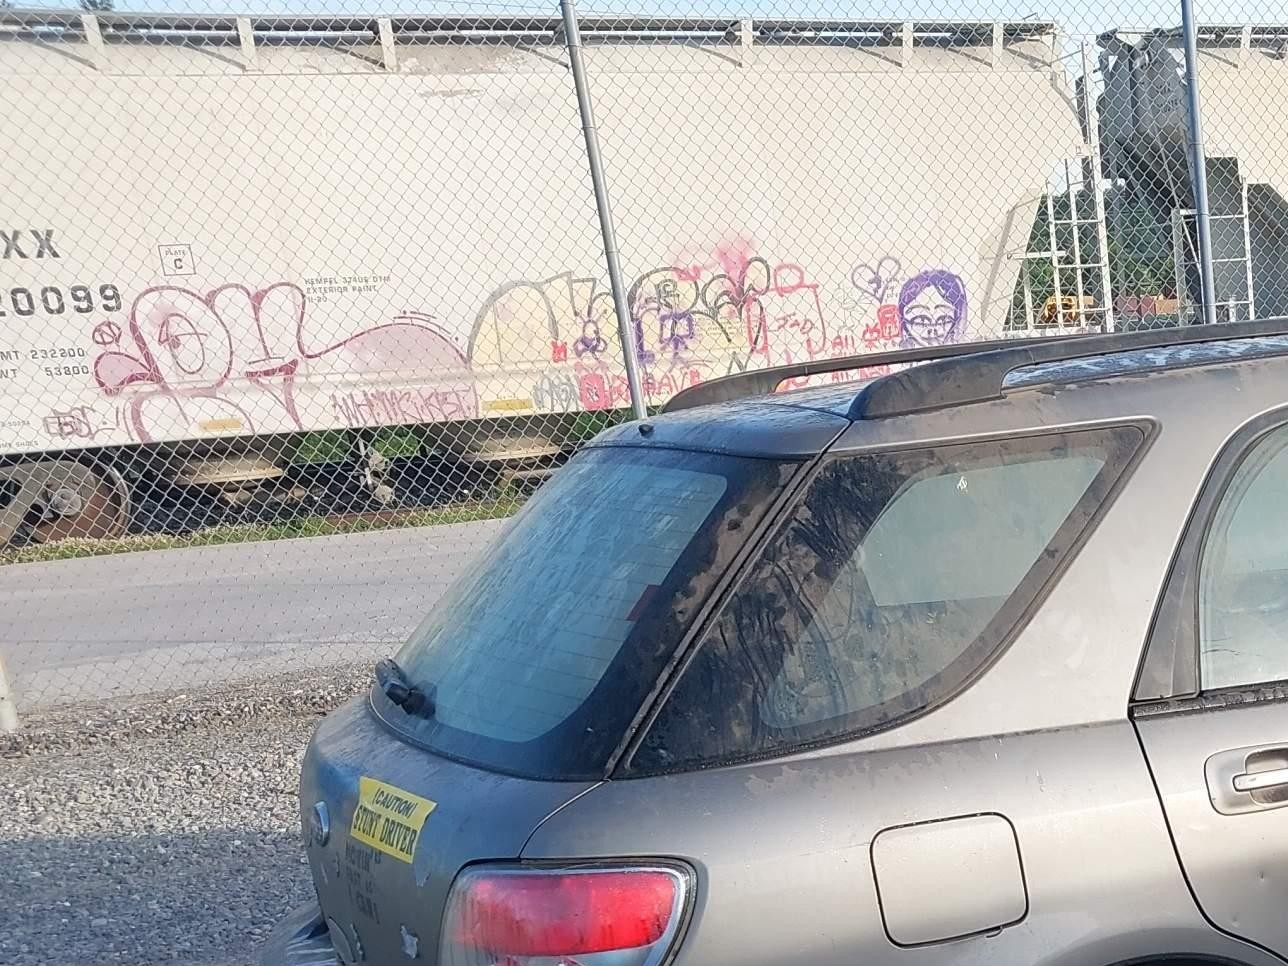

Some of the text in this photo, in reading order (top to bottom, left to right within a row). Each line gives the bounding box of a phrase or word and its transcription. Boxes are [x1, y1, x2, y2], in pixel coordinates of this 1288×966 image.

[174, 258, 183, 270] C
[306, 285, 377, 295] EXTERIOR PAINT
[0, 283, 123, 318] 0099
[30, 346, 86, 361] 232200
[45, 364, 90, 378] 53800
[352, 804, 418, 856] STUNT DRIVER
